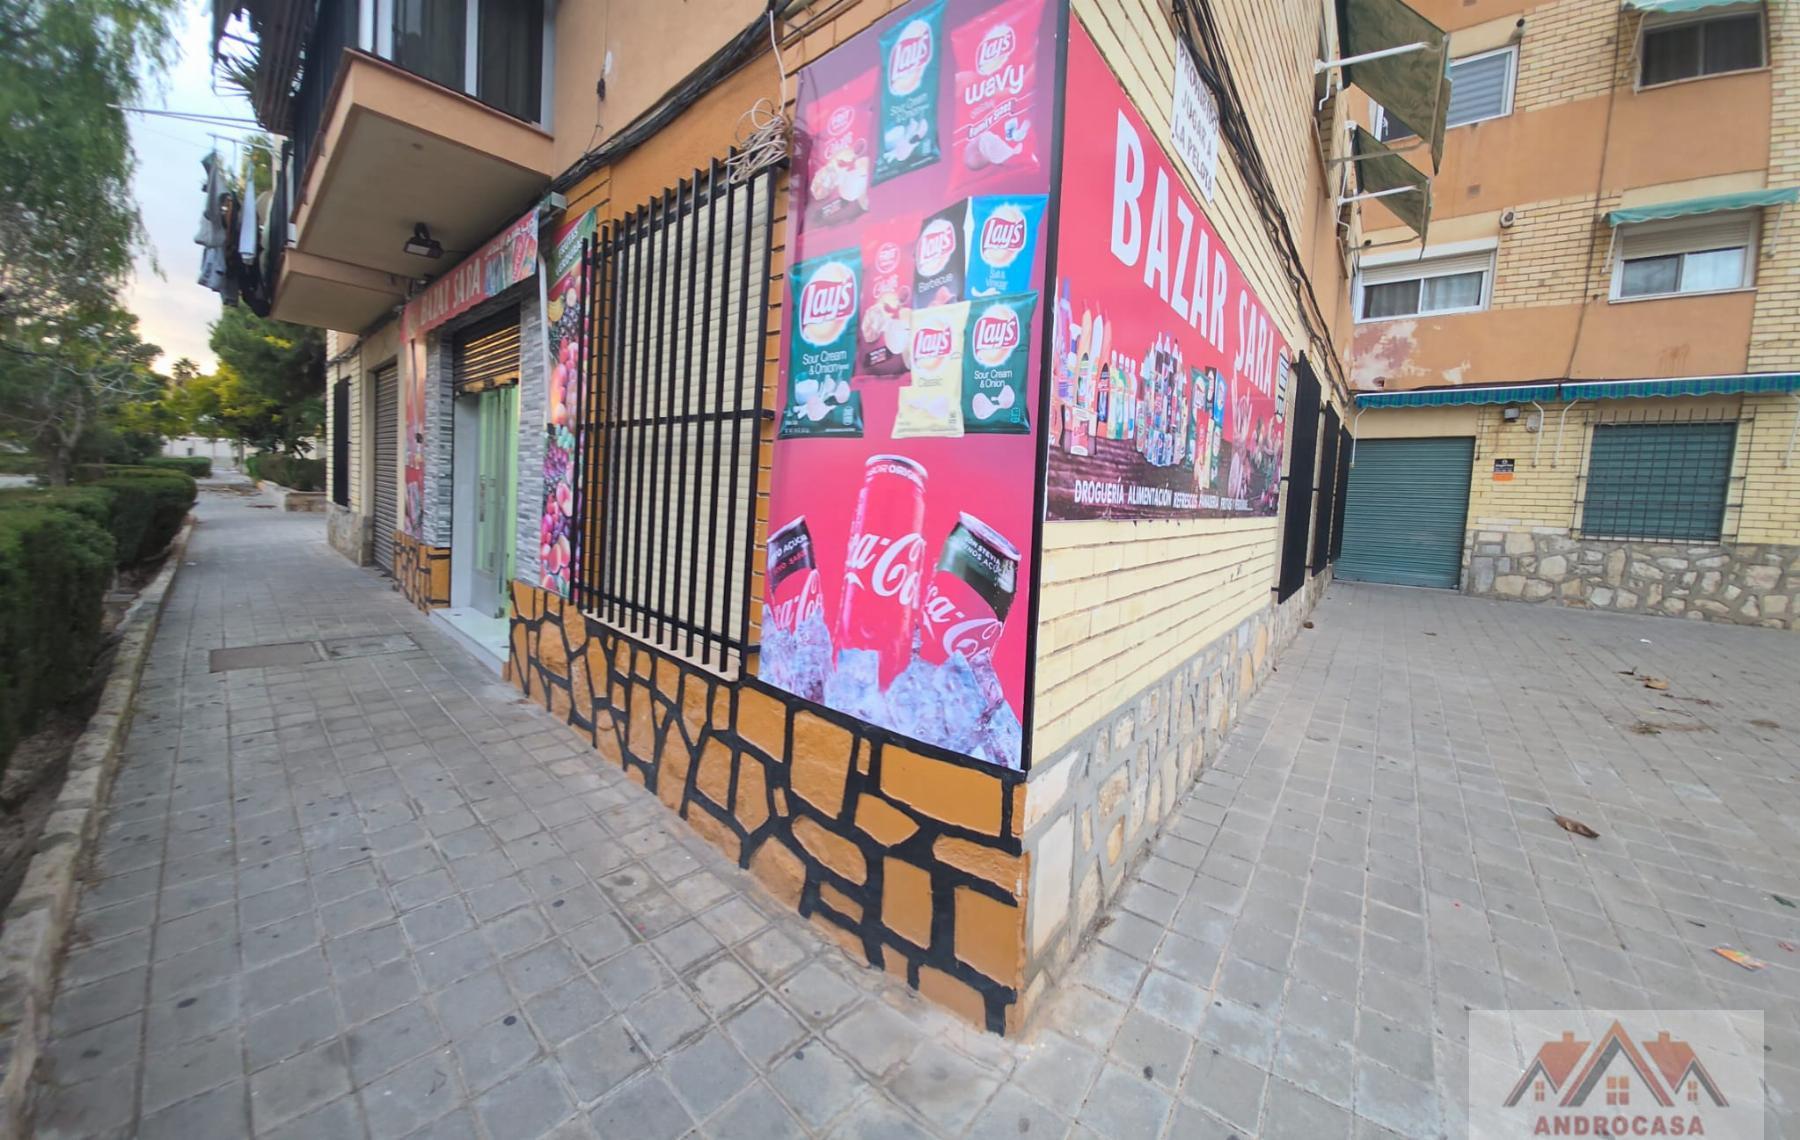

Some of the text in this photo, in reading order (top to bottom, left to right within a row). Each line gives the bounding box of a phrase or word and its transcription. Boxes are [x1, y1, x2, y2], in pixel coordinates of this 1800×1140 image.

[979, 33, 1012, 68] Lay's
[965, 64, 1024, 106] wavy
[919, 228, 951, 262] Lay's
[983, 216, 1023, 251] Lay's
[1110, 107, 1275, 399] BAZAR SARA
[803, 276, 852, 325] Lay's
[913, 327, 951, 358] Lay's
[975, 316, 1016, 348] Lay's
[802, 350, 847, 366] Sour Cream
[974, 369, 1013, 380] Sour Cream
[985, 378, 1006, 389] Onion
[1074, 476, 1124, 505] DROGUERÍA
[1127, 482, 1173, 507] ALIMENTACIÓN
